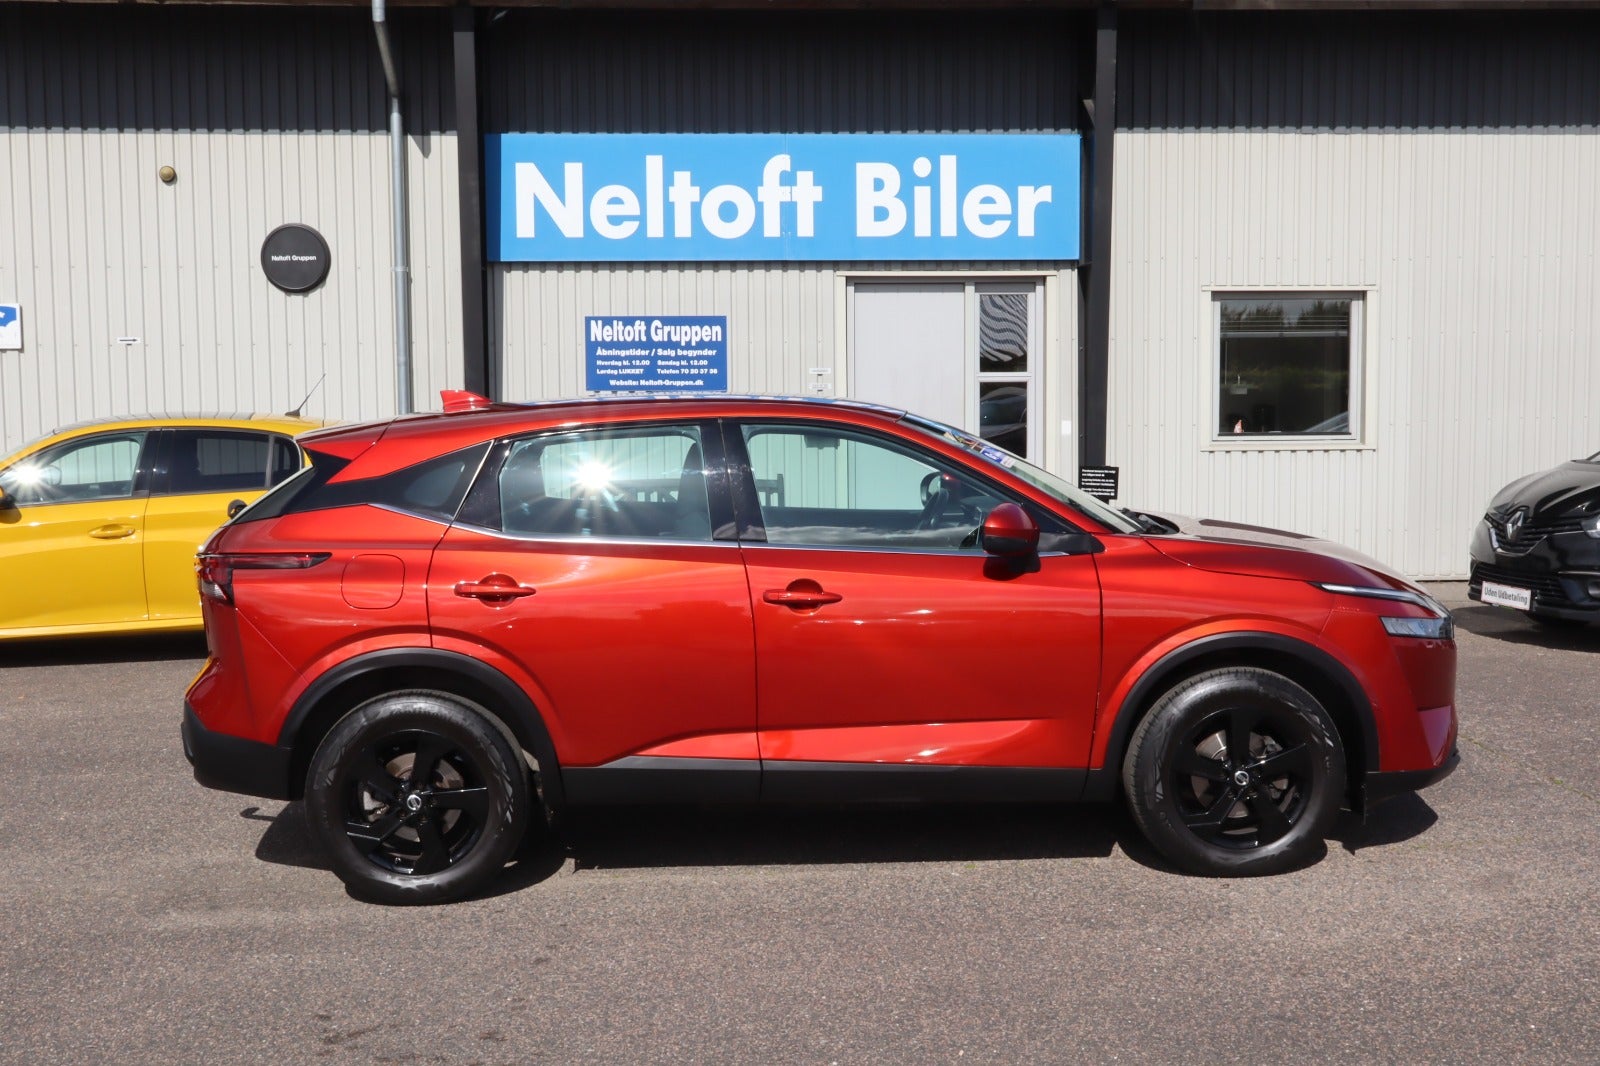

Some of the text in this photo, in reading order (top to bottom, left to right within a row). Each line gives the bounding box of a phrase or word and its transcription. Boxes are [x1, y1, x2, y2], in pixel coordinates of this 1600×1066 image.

[513, 154, 1052, 239] Neltoft Biler
[590, 319, 722, 346] Neltoft Gruppen
[596, 347, 717, 357] Åbningstider / Salg begynder
[1485, 586, 1528, 605] Uden Udbetaling
